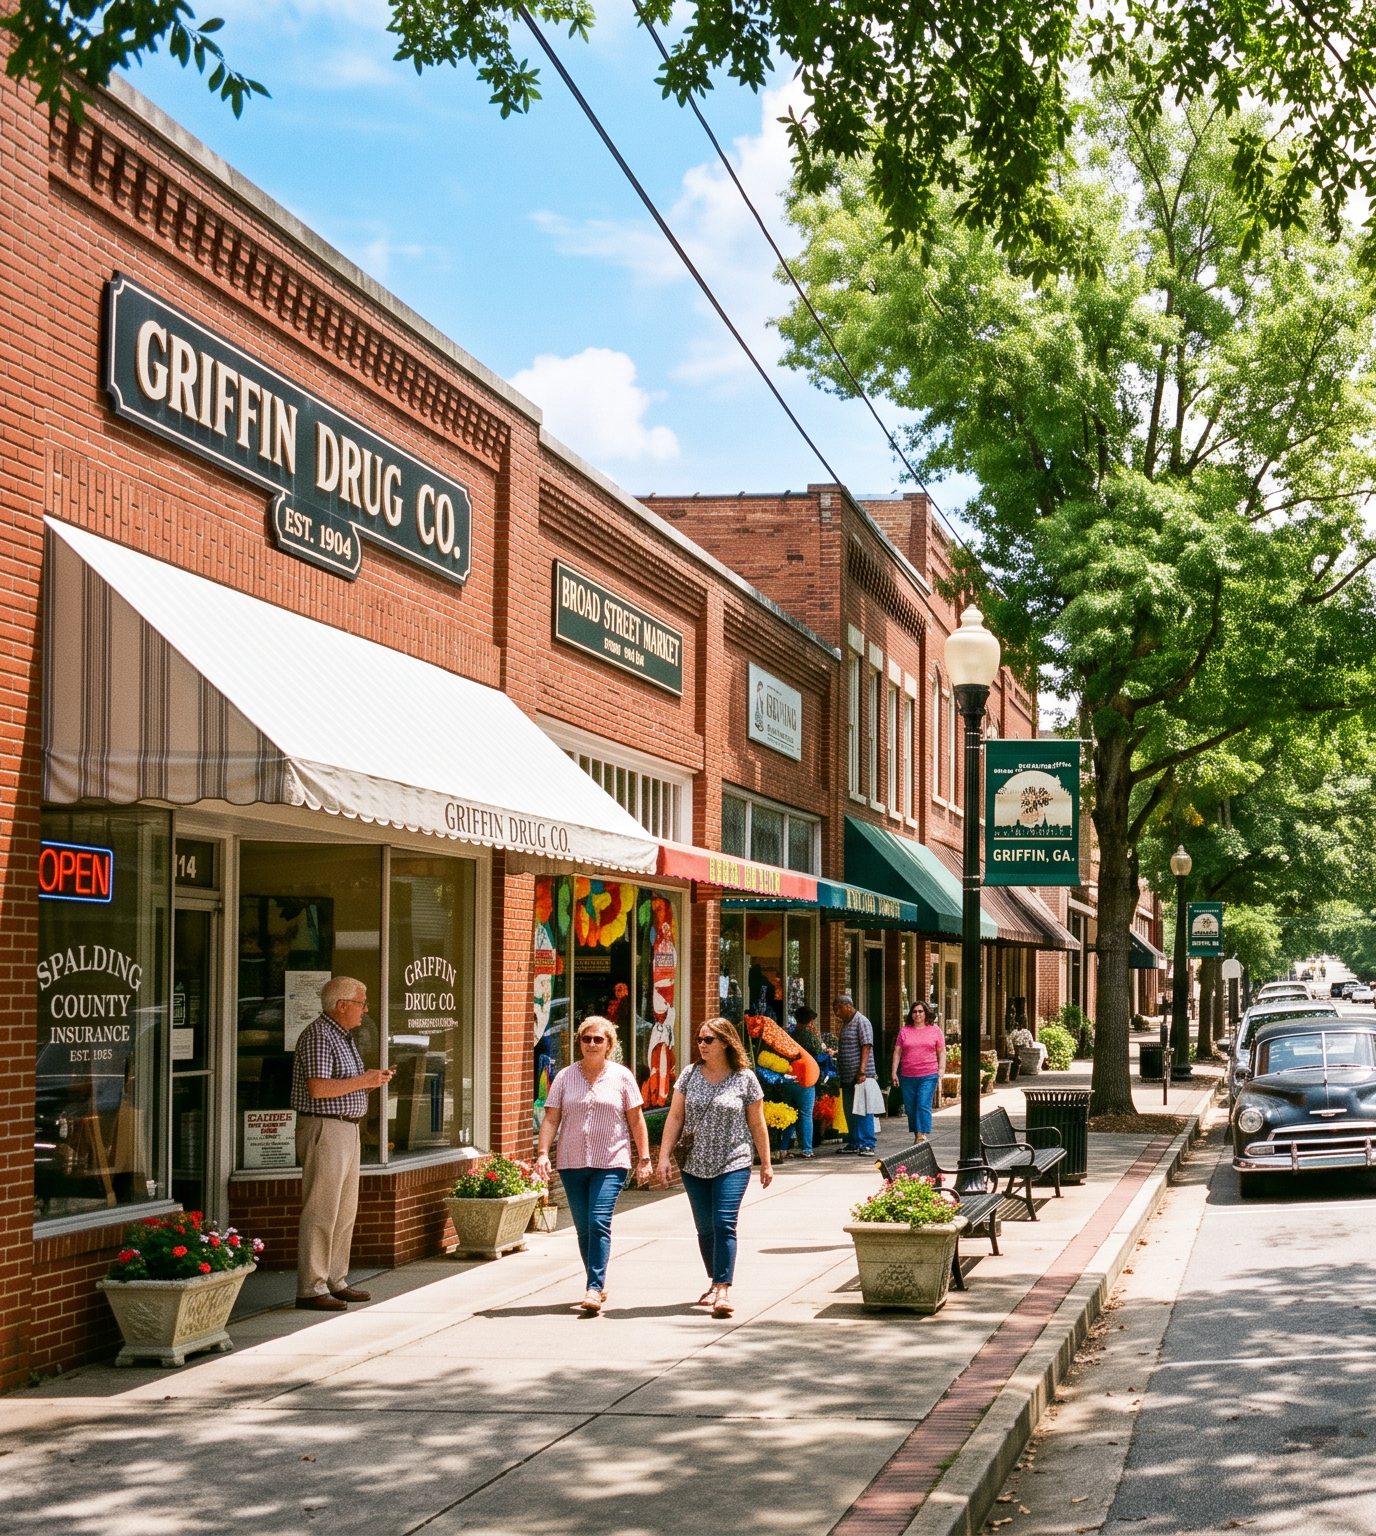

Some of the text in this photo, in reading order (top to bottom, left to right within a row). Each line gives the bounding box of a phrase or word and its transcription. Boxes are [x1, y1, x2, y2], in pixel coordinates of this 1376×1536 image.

[135, 320, 460, 560] GRIFFIN DRUG CO.
[284, 507, 351, 560] EST. 1904
[562, 575, 600, 623] BROAD
[604, 599, 641, 645] STREET
[643, 621, 680, 666] MARKET
[445, 802, 571, 853] GRIFFIN DRUG CO.
[39, 848, 110, 896] OPEN
[993, 849, 1075, 863] GRIFFIN, GA.
[37, 945, 143, 992] SPALDING
[404, 956, 457, 988] GRIFFIN
[50, 994, 131, 1019] COUNTY
[404, 992, 457, 1011] DRUG CO.
[49, 1025, 130, 1044] INSURANCE
[69, 1050, 91, 1062] EST.
